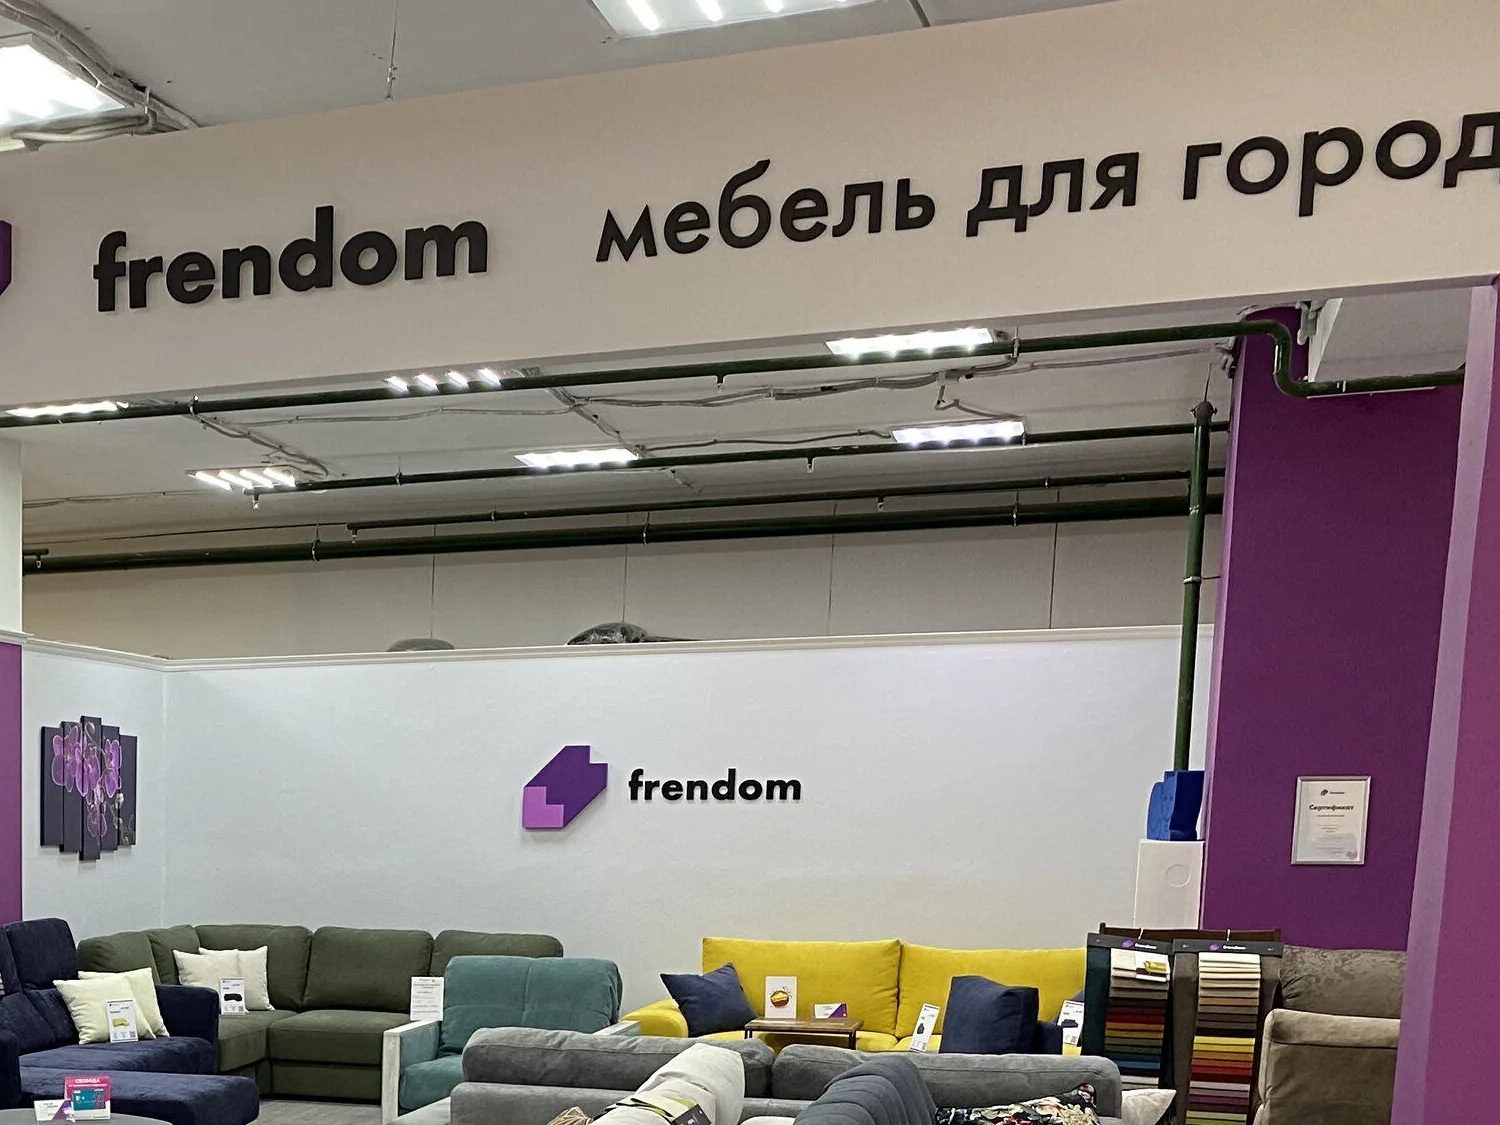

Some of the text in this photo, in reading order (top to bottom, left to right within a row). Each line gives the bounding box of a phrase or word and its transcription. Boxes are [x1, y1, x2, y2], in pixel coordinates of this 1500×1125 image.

[596, 112, 1500, 263] мебель для город
[92, 204, 489, 313] frendom
[627, 767, 802, 801] frendom
